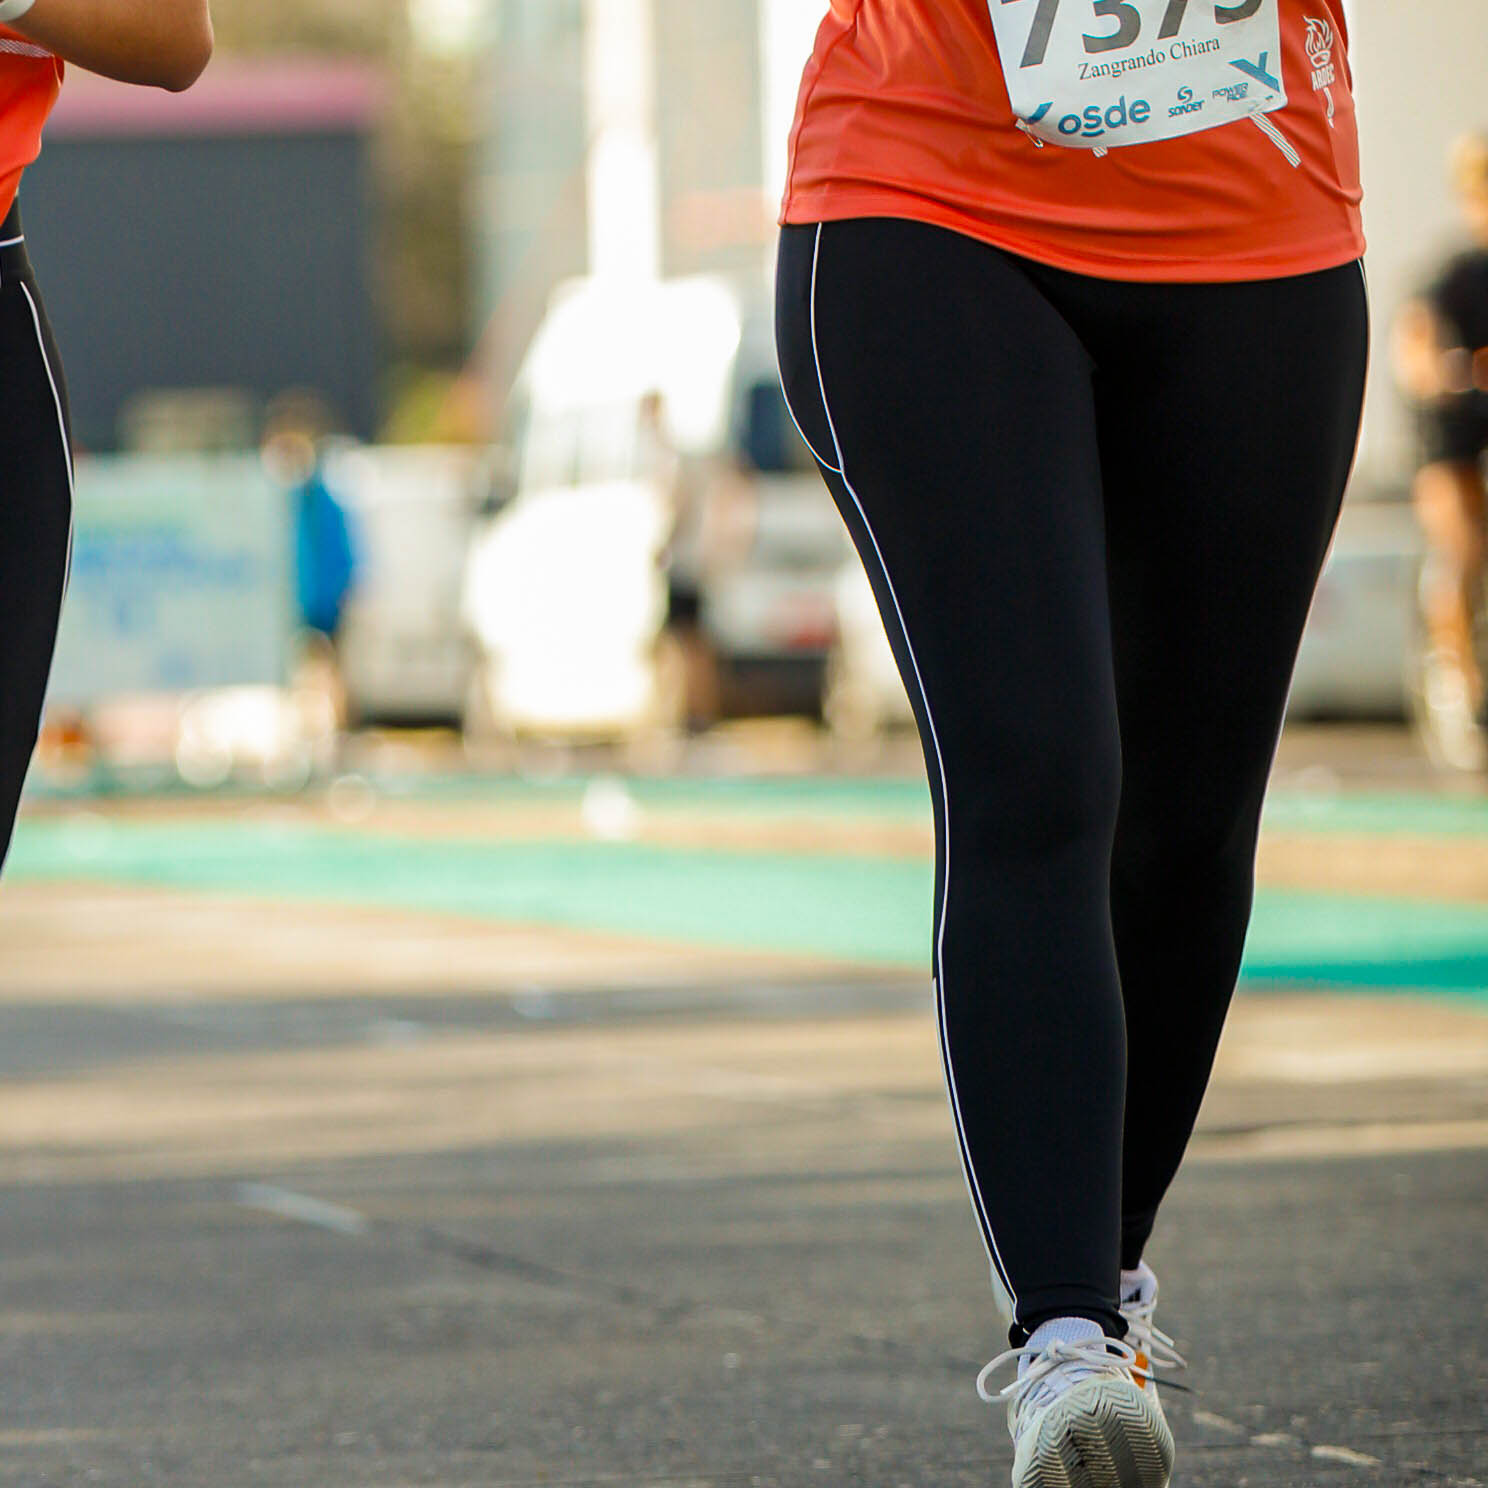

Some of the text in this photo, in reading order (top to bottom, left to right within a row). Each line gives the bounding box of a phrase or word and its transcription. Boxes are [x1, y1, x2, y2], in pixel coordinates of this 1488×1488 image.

[1078, 36, 1221, 81] Zangrando Chiara
[1058, 96, 1151, 138] osde
